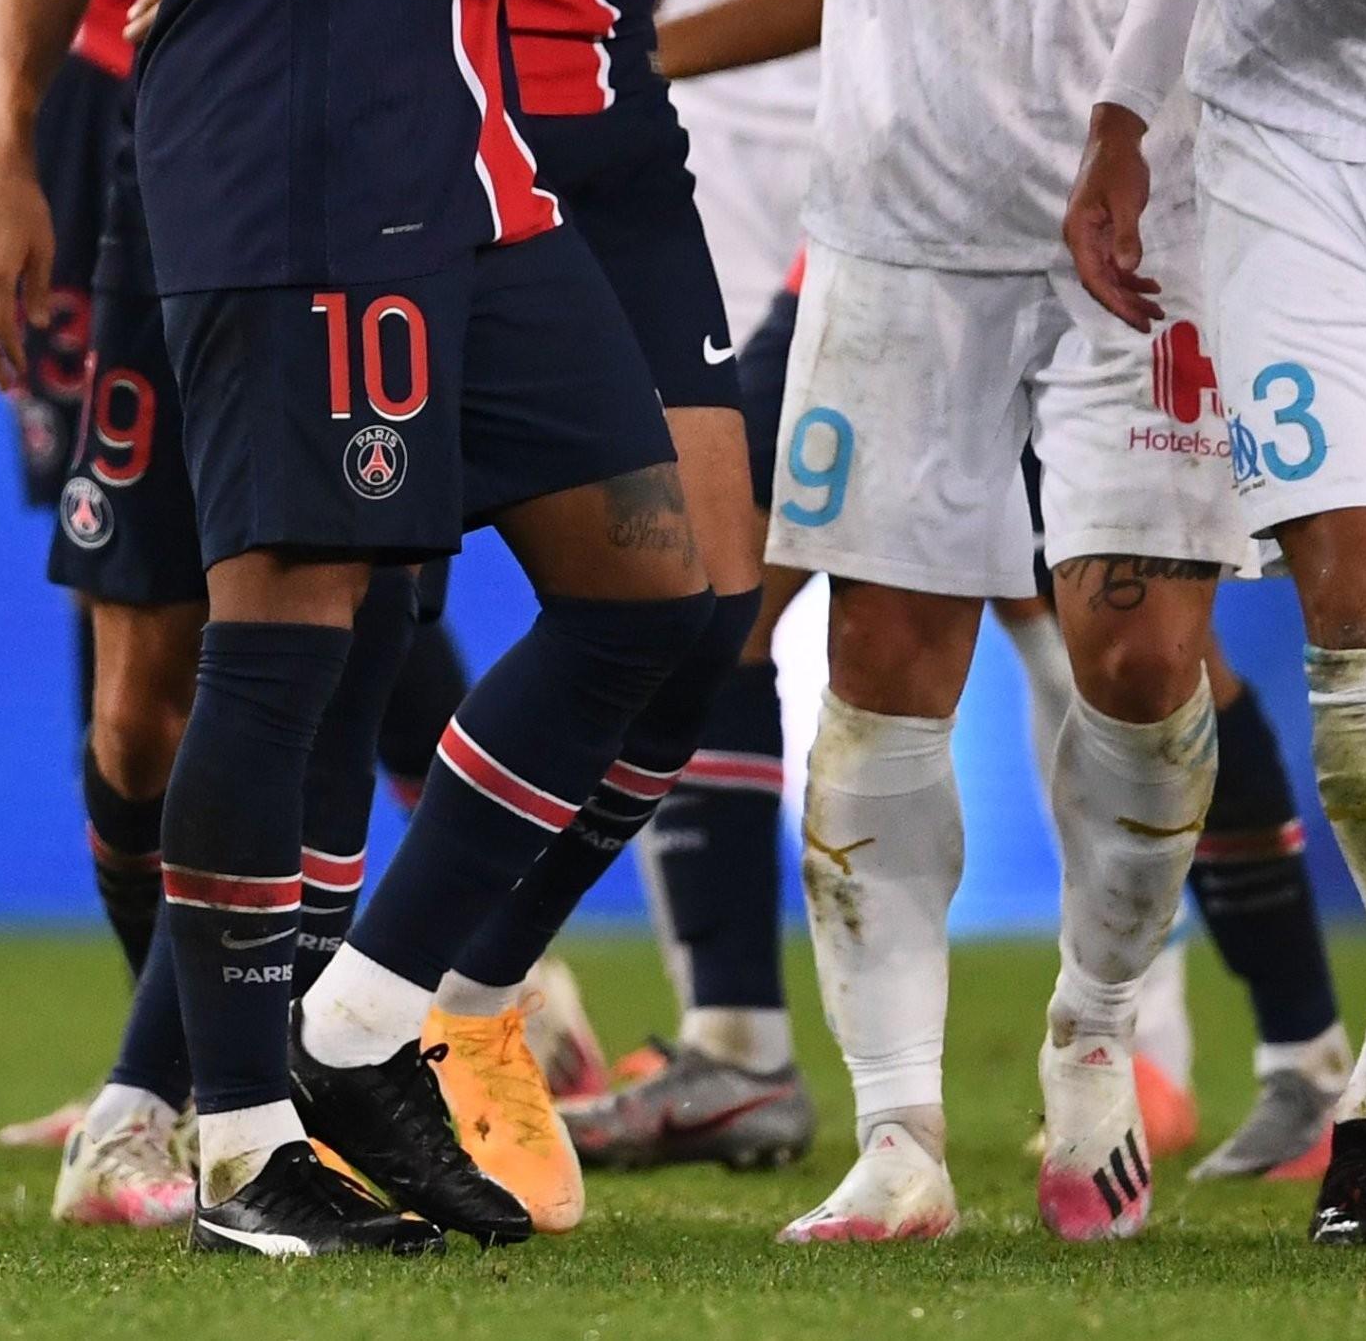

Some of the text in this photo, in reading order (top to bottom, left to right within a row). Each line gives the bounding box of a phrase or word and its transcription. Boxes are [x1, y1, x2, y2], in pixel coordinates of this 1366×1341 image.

[311, 293, 429, 422] 10
[355, 429, 398, 447] PARIS
[1129, 427, 1231, 458] Hotels.c
[1253, 362, 1328, 481] 3
[780, 406, 854, 527] 9
[297, 933, 343, 951] RIS
